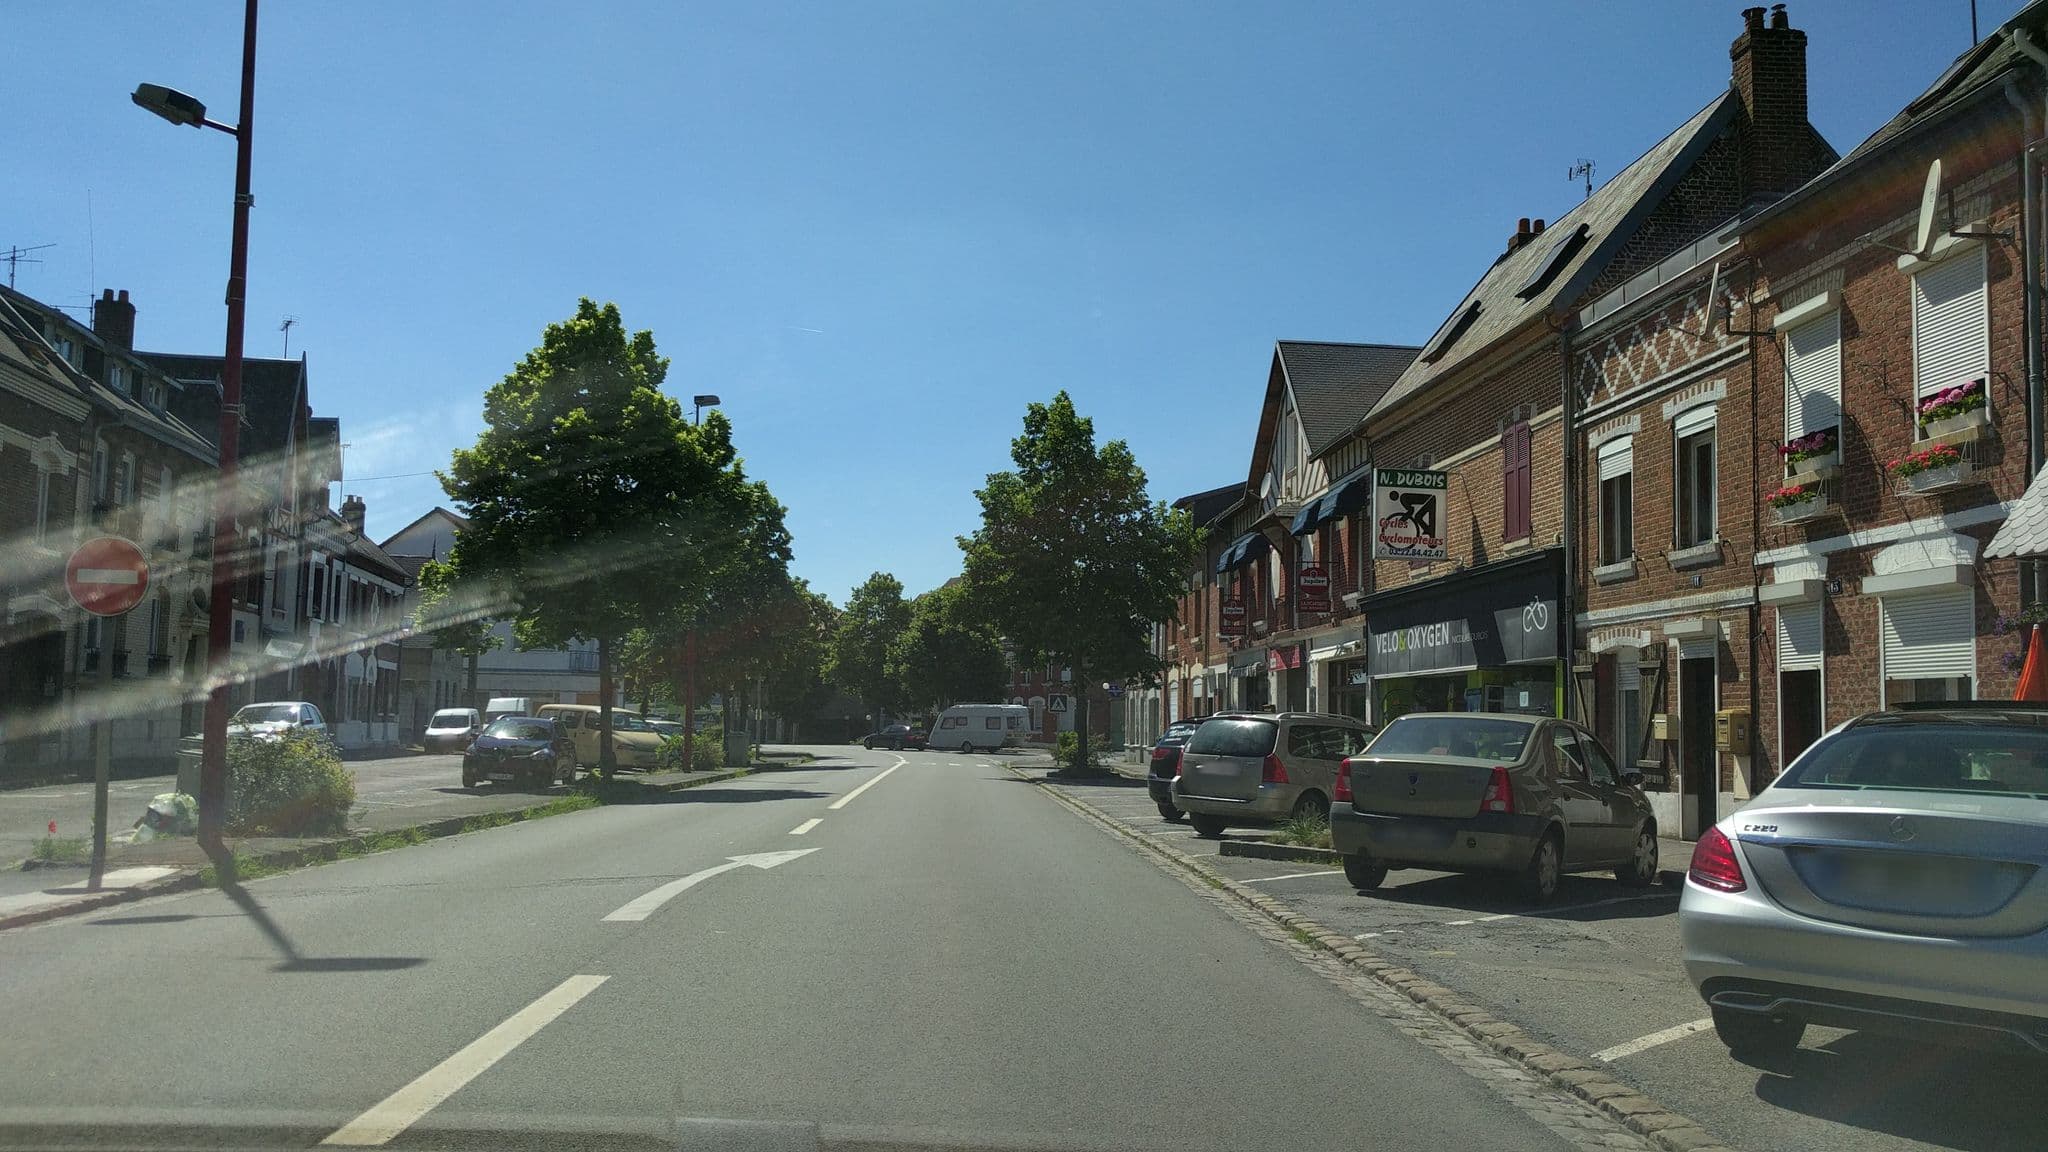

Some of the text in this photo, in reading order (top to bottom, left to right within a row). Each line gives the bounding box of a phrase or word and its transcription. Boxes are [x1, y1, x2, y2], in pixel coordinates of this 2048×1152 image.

[1380, 472, 1445, 487] N. DUBOIS
[1379, 517, 1408, 529] Cycles
[1379, 533, 1444, 546] Cyclomoteurs
[1407, 622, 1449, 650] OXYGEN
